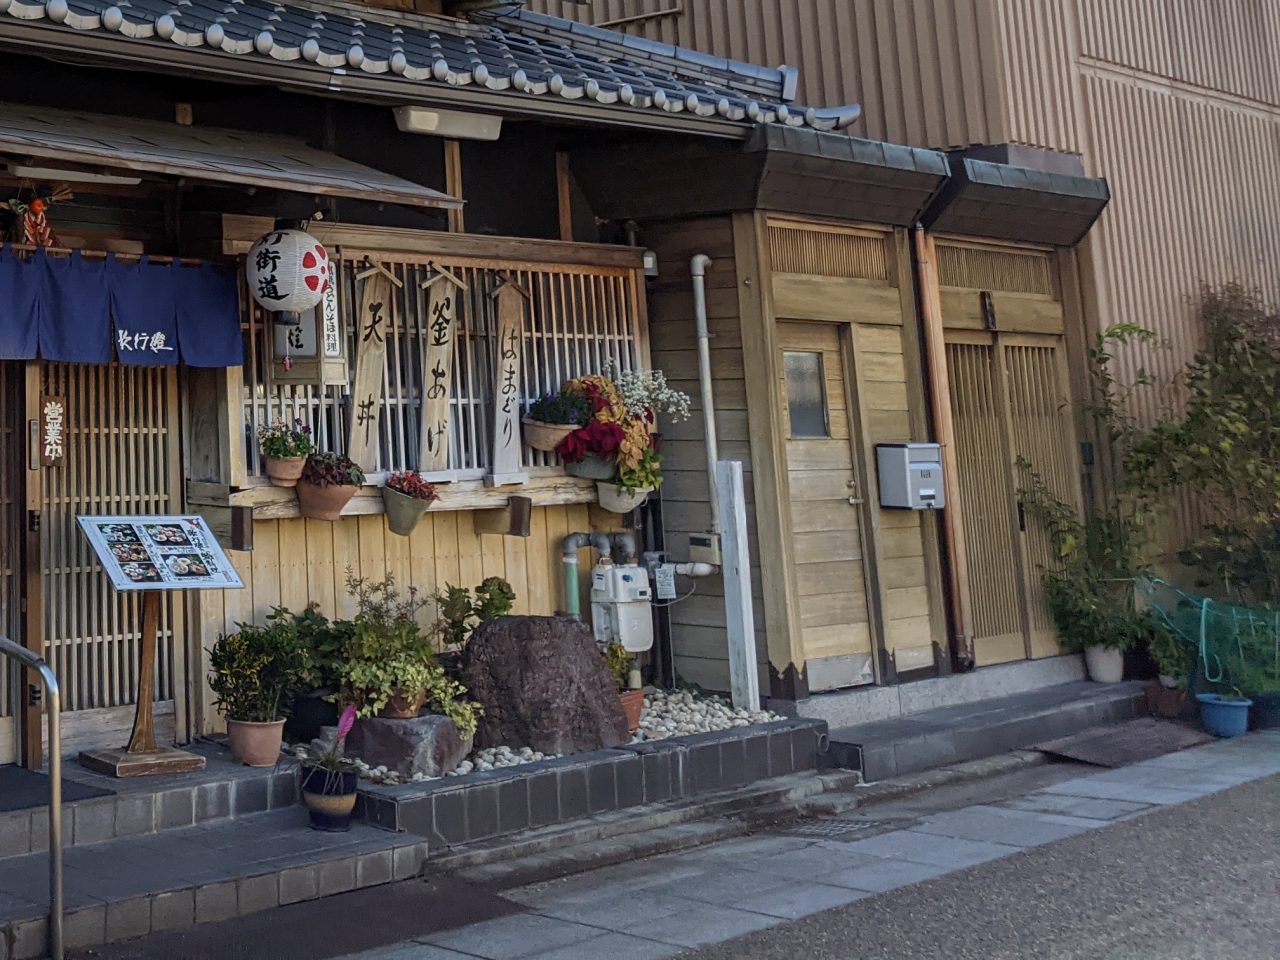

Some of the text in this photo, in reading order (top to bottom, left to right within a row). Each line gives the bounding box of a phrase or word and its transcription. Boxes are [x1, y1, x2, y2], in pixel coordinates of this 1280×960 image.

[43, 401, 64, 461] 営業中
[357, 302, 384, 446] 天丼
[426, 296, 452, 459] 釜あげ
[500, 324, 521, 449] はまぐり
